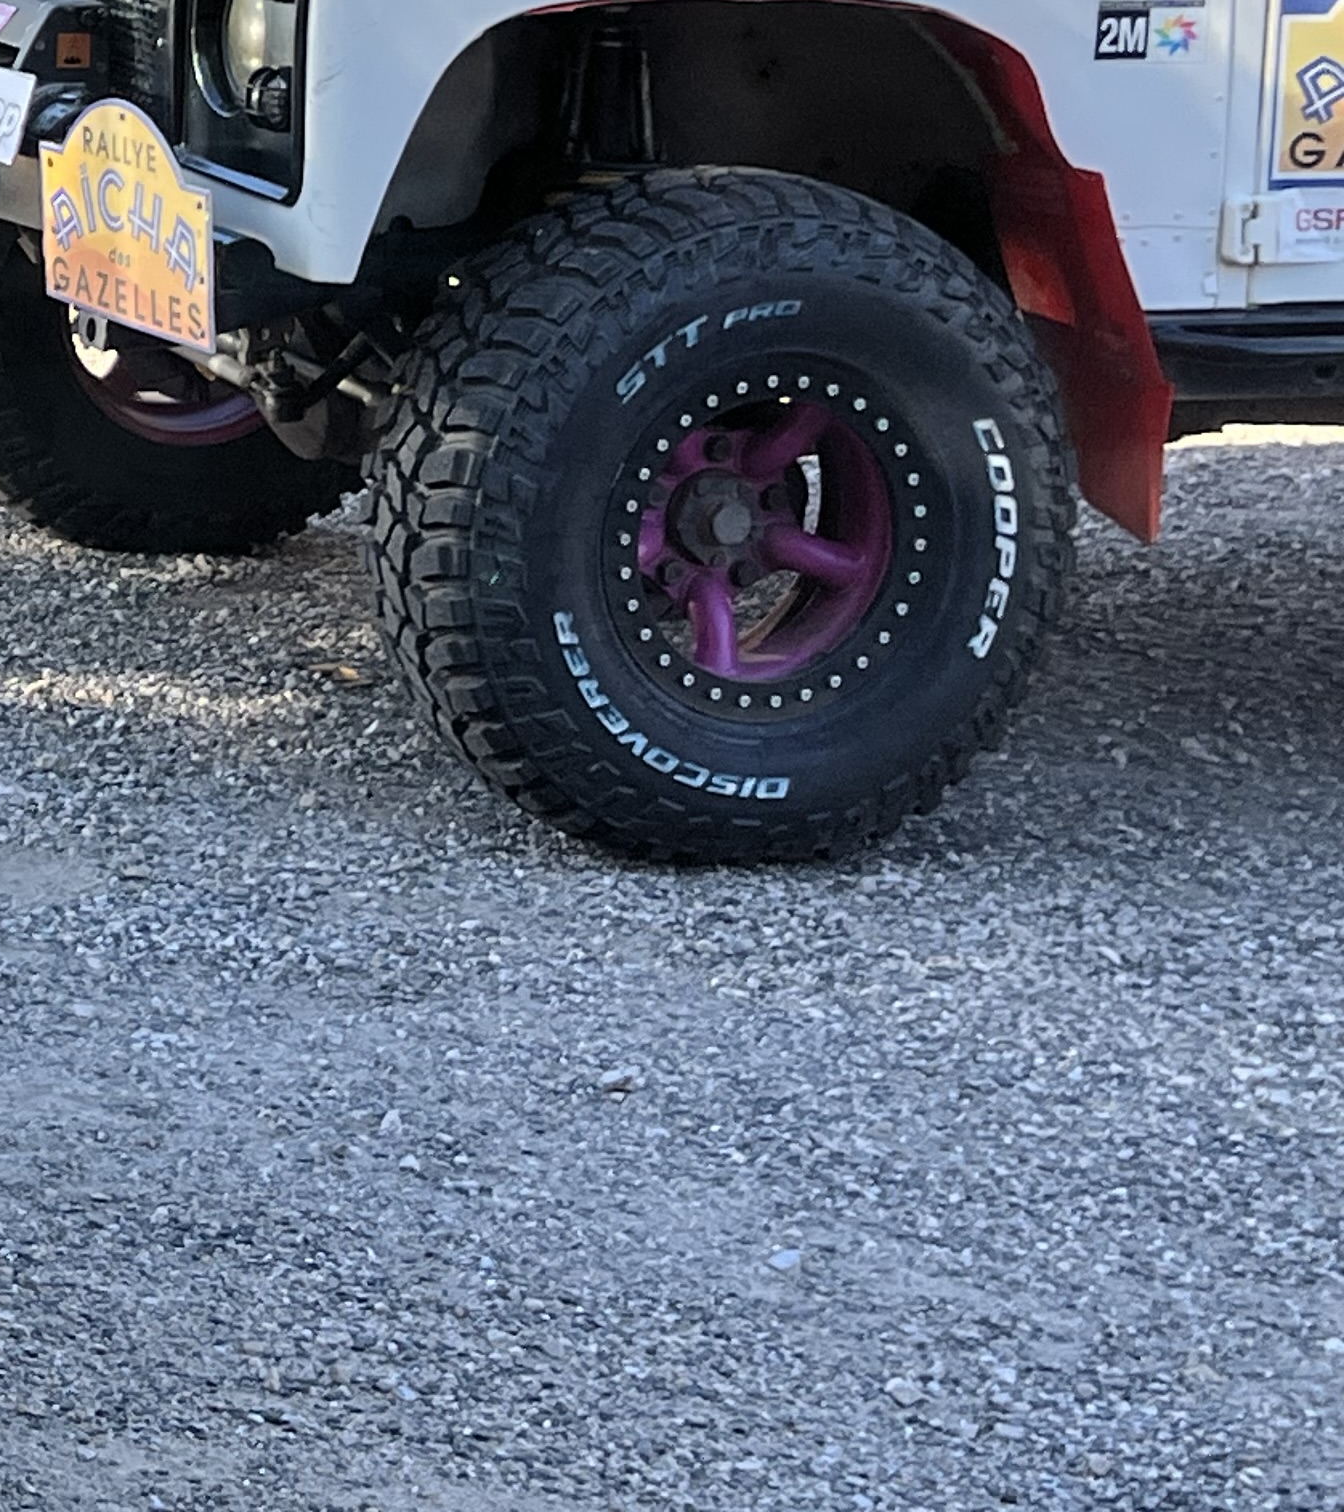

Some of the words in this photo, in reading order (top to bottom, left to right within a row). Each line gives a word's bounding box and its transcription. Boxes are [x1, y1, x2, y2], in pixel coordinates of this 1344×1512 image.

[1099, 16, 1148, 53] 2M
[83, 126, 157, 173] RALLYE
[52, 256, 206, 340] GAZELLES
[108, 248, 131, 268] des
[616, 316, 708, 404] STT
[722, 299, 802, 331] PRO
[967, 417, 1018, 659] COOPER
[553, 611, 790, 800] DISCOVERER
